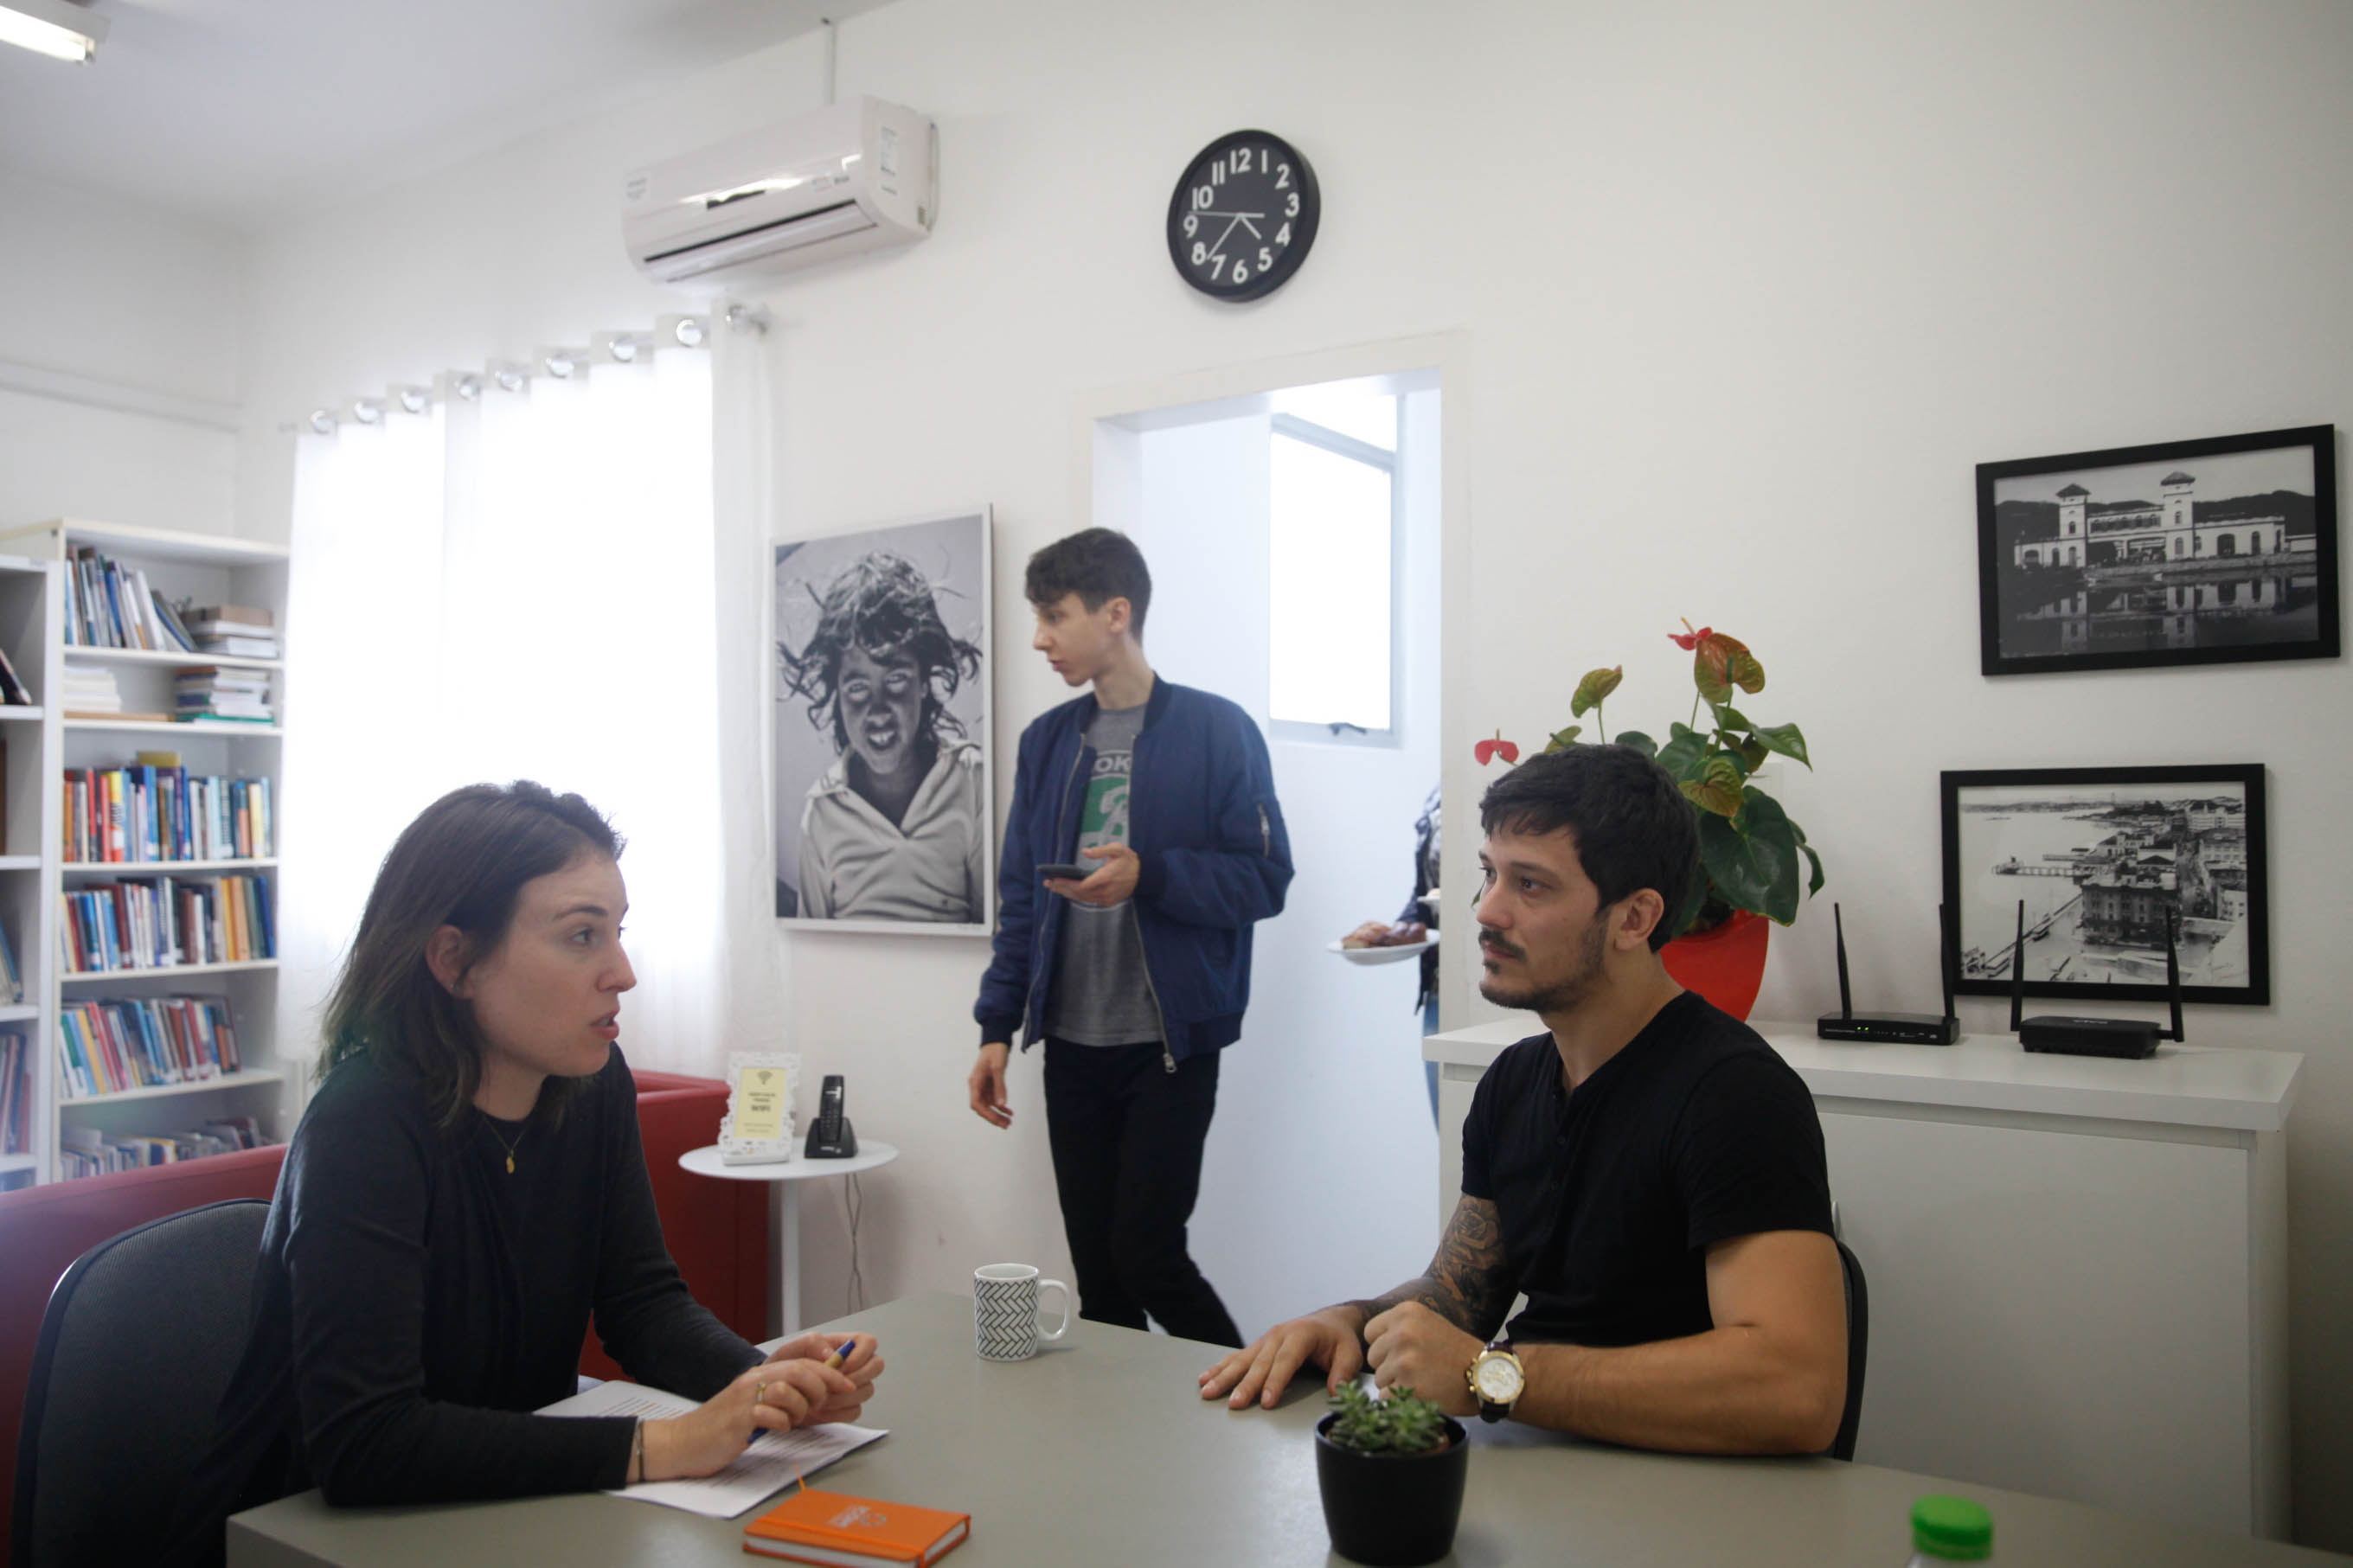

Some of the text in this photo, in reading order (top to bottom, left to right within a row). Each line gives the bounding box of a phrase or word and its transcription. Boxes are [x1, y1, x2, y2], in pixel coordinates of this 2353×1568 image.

[1212, 160, 1225, 186] 11
[1230, 147, 1252, 175] 12
[1261, 149, 1268, 174] 1
[1275, 163, 1290, 189] 2
[1192, 185, 1214, 211] 10
[1285, 192, 1299, 217] 3
[1183, 214, 1198, 239] 9
[1275, 222, 1291, 246] 4
[1191, 241, 1207, 266] 8
[1257, 246, 1273, 272] 5
[1211, 253, 1227, 280] 7
[1233, 259, 1248, 284] 6
